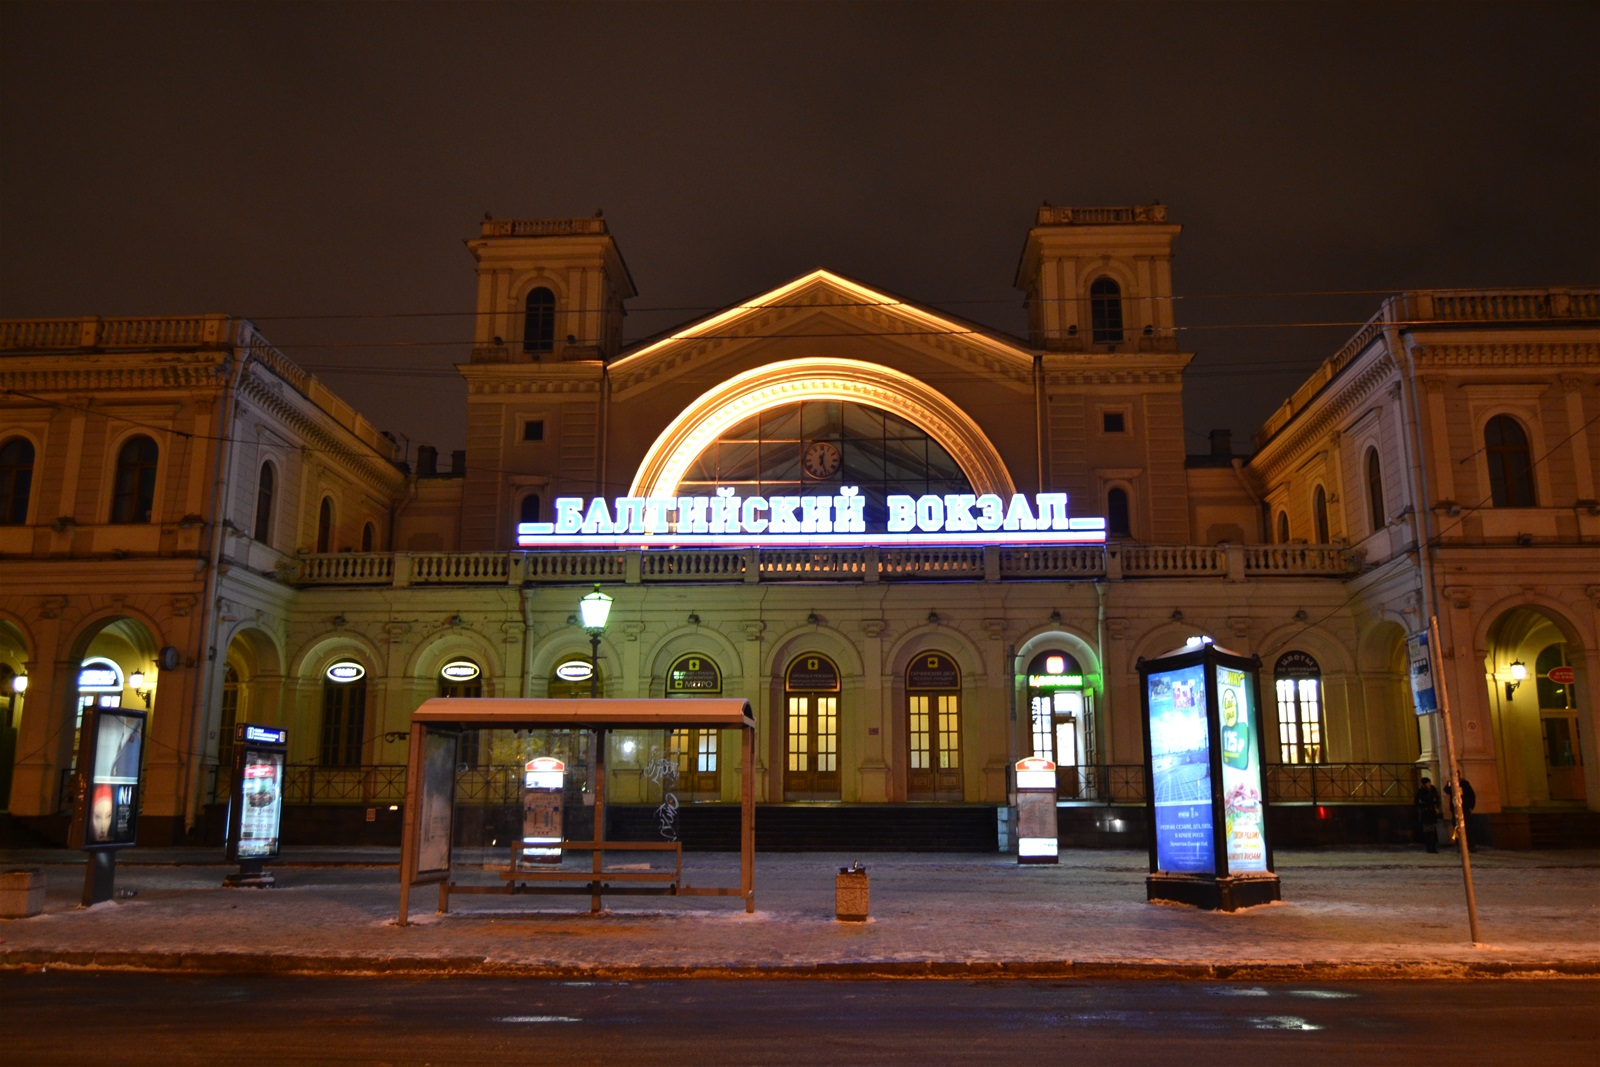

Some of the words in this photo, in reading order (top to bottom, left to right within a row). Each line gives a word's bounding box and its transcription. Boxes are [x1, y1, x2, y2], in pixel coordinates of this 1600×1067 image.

[555, 486, 865, 534] БАЛТИЙСКИЙ
[887, 493, 1068, 532] ВОКЗАЛ
[684, 680, 713, 689] МЕТРО
[1217, 667, 1245, 687] SUBWAY
